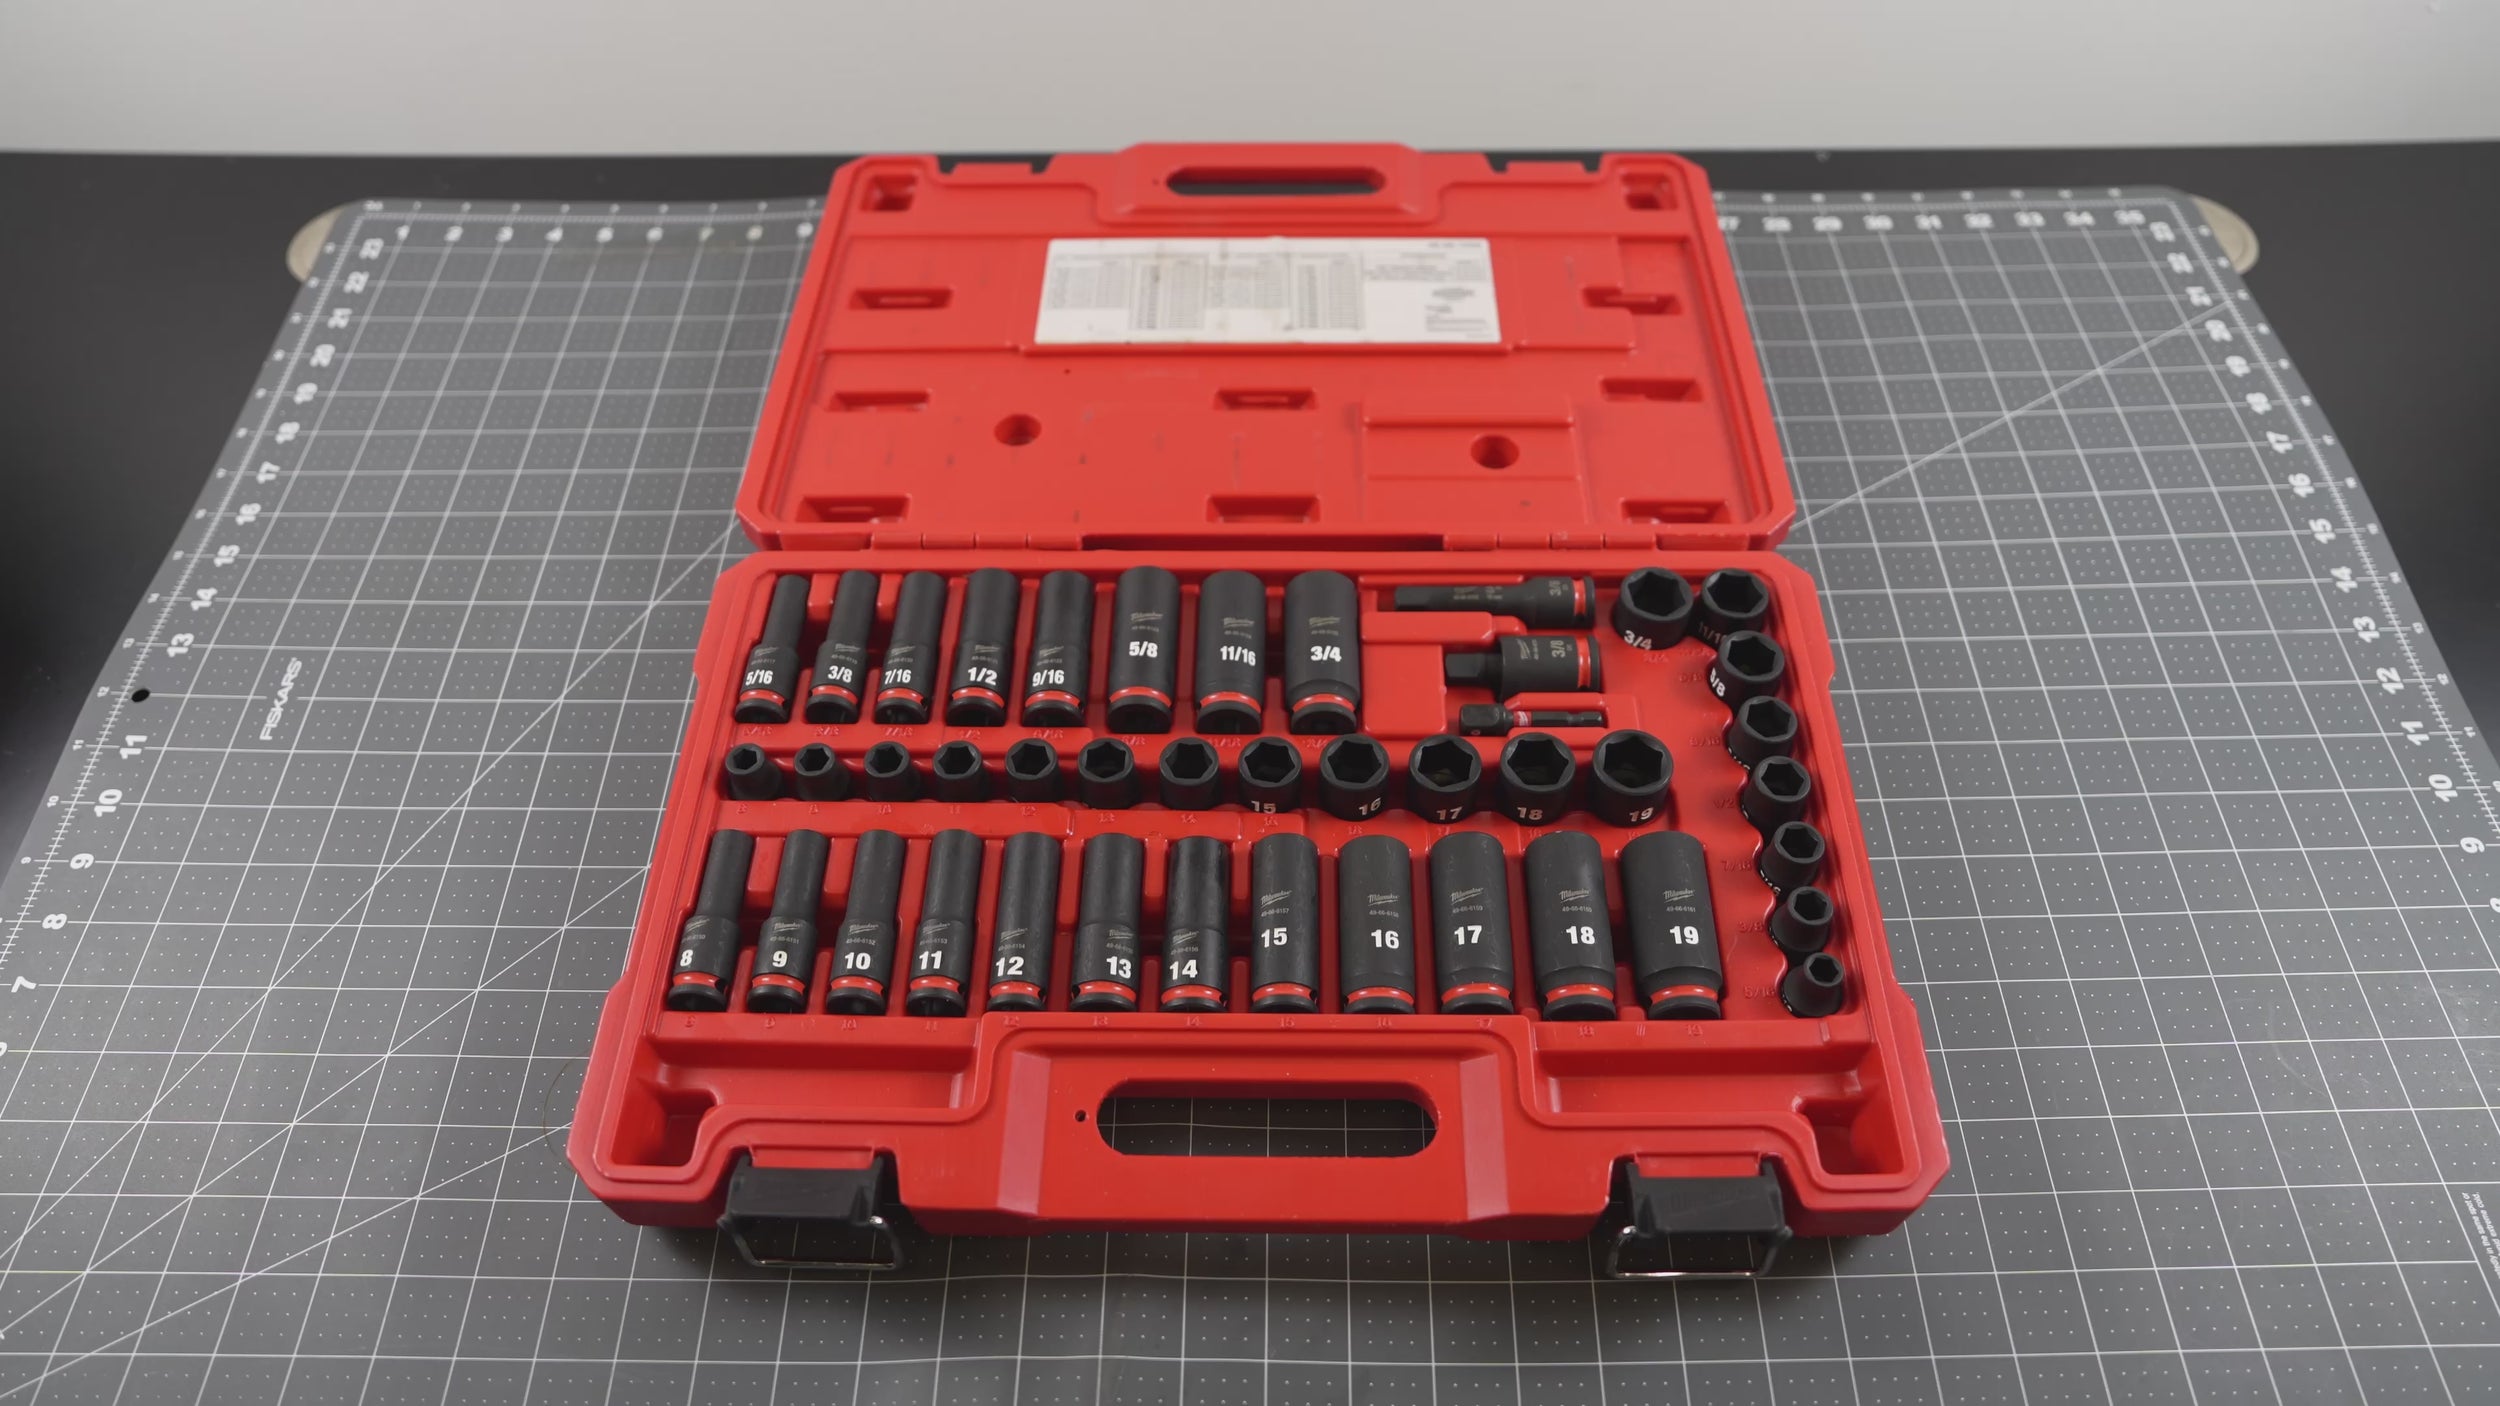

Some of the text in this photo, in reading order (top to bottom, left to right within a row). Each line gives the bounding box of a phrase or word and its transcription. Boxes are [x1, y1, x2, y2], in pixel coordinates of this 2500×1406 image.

[2266, 431, 2294, 454] 17
[256, 461, 280, 483] 17
[2288, 472, 2315, 498] 16
[236, 502, 261, 525] 16
[2308, 518, 2336, 544] 15
[213, 544, 240, 567] 15
[2330, 565, 2358, 593] 14
[191, 587, 218, 610] 14
[2352, 615, 2381, 643] 13
[167, 632, 194, 657] 13
[1129, 641, 1157, 657] 5/8
[1551, 640, 1567, 659] 3/8
[1624, 629, 1653, 651] 3/4
[1221, 646, 1255, 666] 11/16
[1311, 646, 1341, 662] 3/4
[746, 670, 773, 685] 5/16
[828, 666, 852, 682] 3/8
[885, 669, 911, 684] 7/16
[968, 667, 997, 685] 1/2
[1033, 670, 1064, 687] 9/16
[1709, 667, 1727, 698] 5/8
[2376, 667, 2404, 694] 12
[259, 657, 303, 740] FISKARS
[2400, 721, 2430, 746] 11
[120, 735, 148, 759] 11
[2428, 773, 2459, 802] 10
[94, 788, 123, 817] 10
[1251, 800, 1277, 814] 15
[1358, 797, 1382, 817] 16
[1435, 805, 1462, 821] 17
[1516, 806, 1543, 821] 18
[1629, 806, 1654, 822] 19
[1721, 860, 1752, 872] 7/16
[1368, 892, 1399, 906] Milwaukee
[1663, 888, 1695, 903] Milwaukee
[42, 913, 67, 930] 8
[1737, 920, 1764, 934] 3/8
[1262, 928, 1287, 947] 15
[1371, 930, 1399, 949] 16
[1455, 925, 1482, 945] 17
[1566, 926, 1595, 944] 18
[1670, 926, 1699, 944] 19
[680, 950, 693, 966] 8
[773, 951, 787, 967] 9
[845, 952, 870, 969] 10
[919, 951, 941, 970] 11
[996, 957, 1024, 976] 12
[1107, 956, 1131, 978] 13
[1170, 960, 1197, 980] 14
[11, 975, 37, 993] 7
[1743, 985, 1776, 999] 5/16
[2464, 1200, 2477, 1216] spot
[2472, 1216, 2486, 1235] same
[2480, 1210, 2498, 1237] extreme
[2480, 1235, 2491, 1247] the
[2486, 1247, 2494, 1255] in
